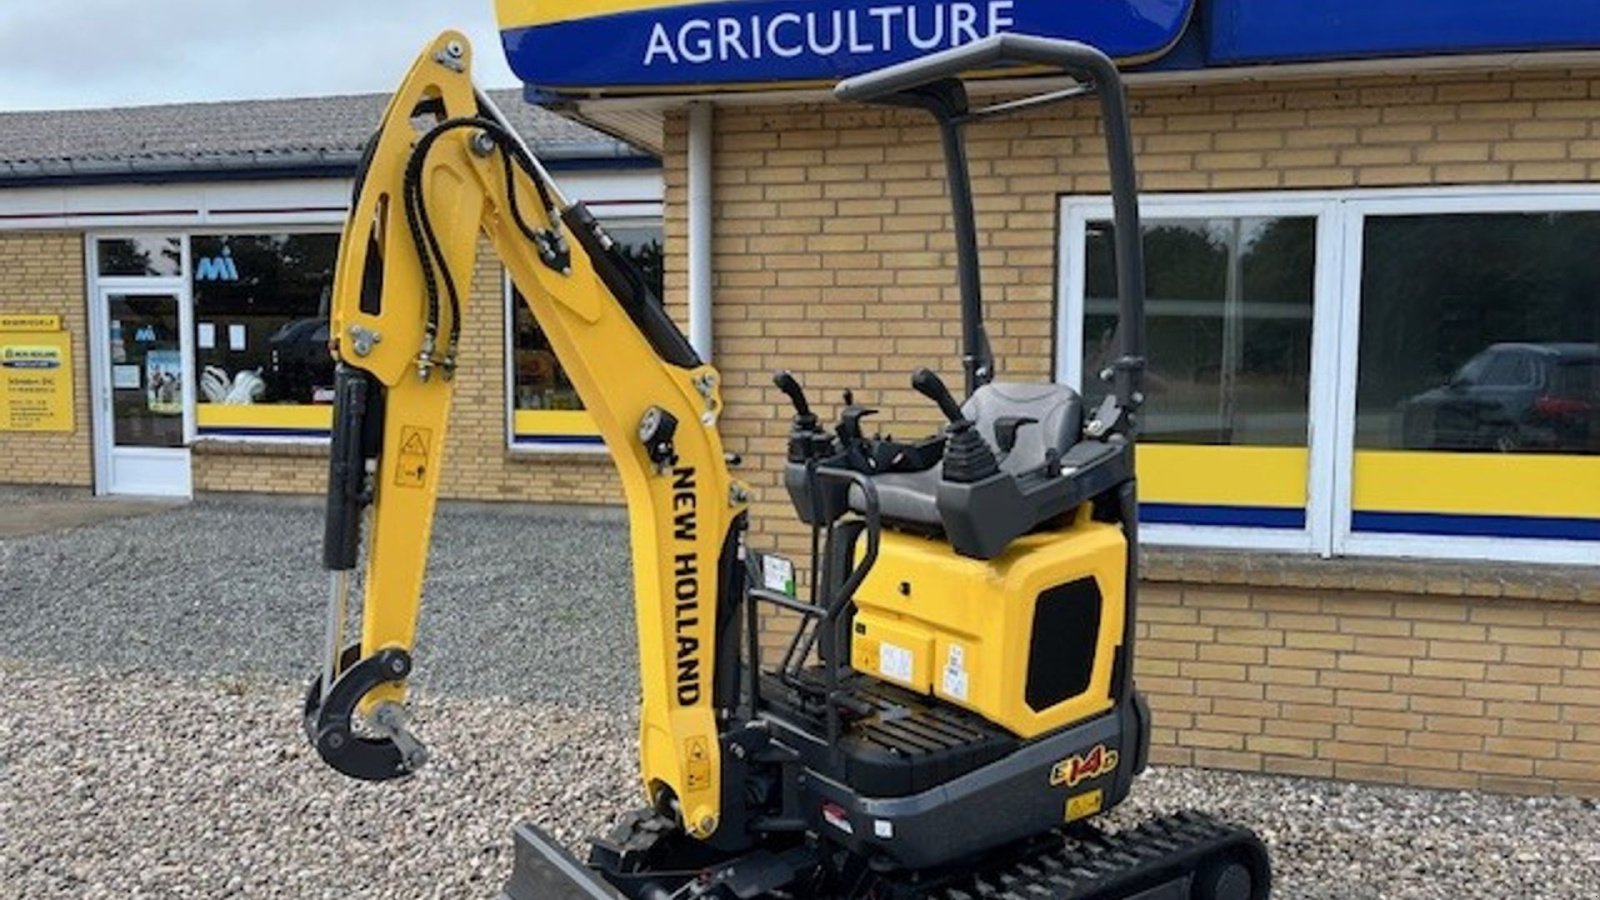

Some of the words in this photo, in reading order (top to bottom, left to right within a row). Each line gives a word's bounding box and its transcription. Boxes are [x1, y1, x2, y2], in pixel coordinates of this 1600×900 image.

[644, 1, 1014, 65] AGRICULTURE
[672, 466, 697, 541] NEW
[674, 553, 700, 708] HOLLAND
